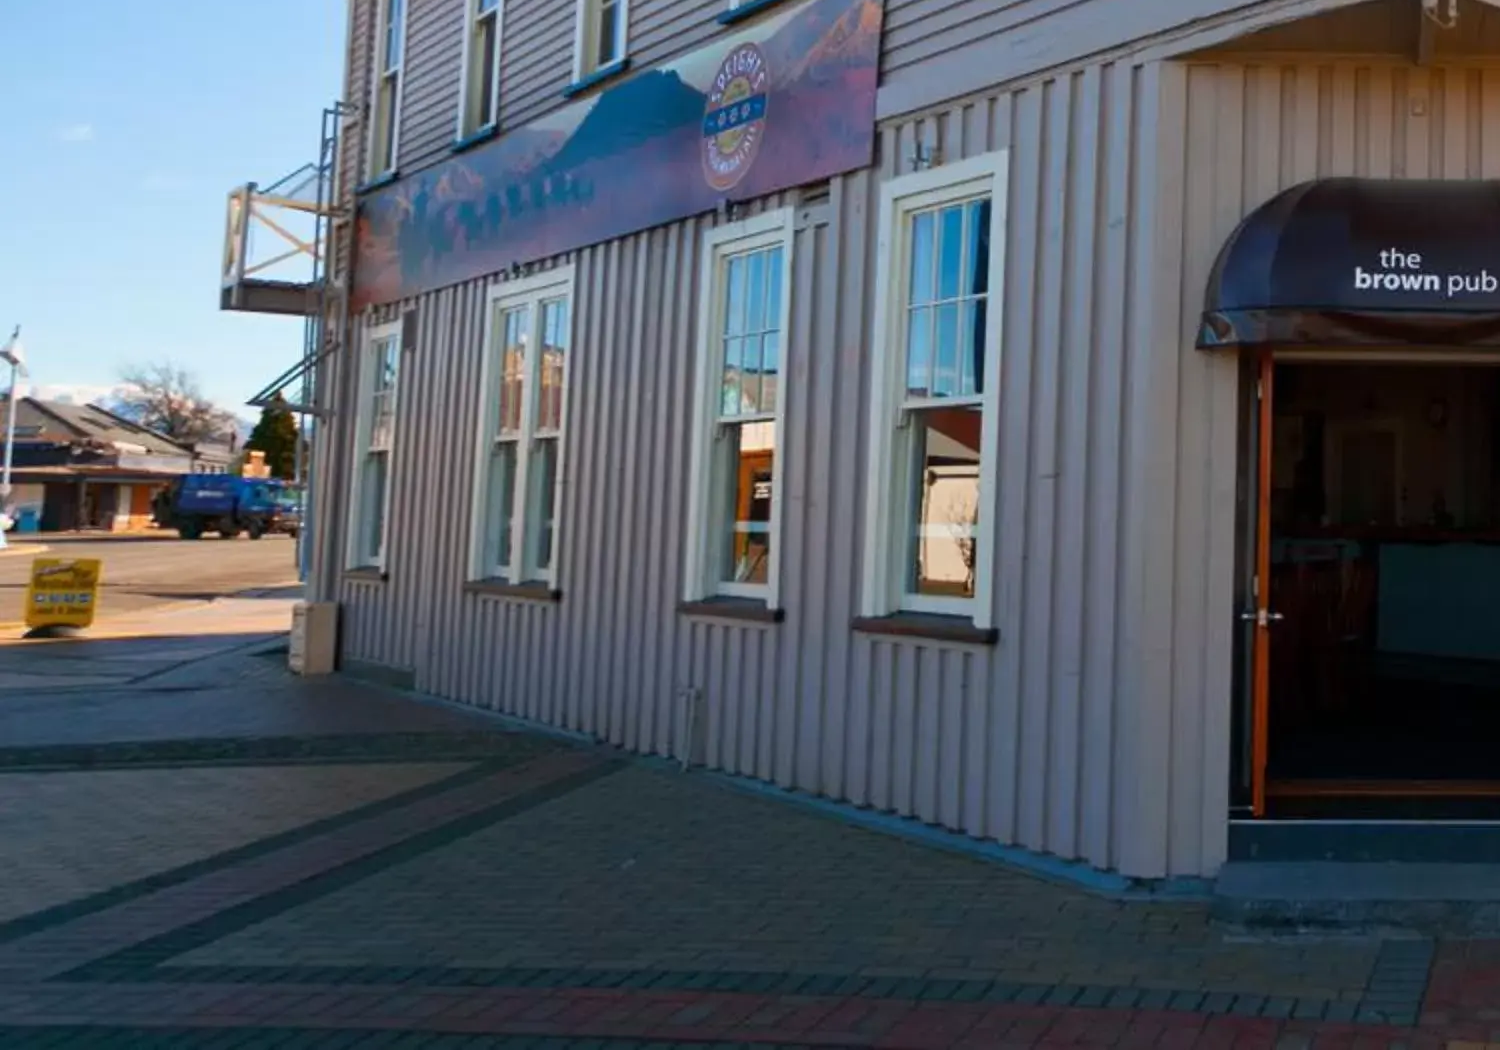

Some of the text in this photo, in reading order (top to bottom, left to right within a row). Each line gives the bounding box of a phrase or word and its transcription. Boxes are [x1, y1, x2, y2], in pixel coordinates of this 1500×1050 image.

[1379, 247, 1422, 269] the
[1354, 266, 1499, 297] brown pub
